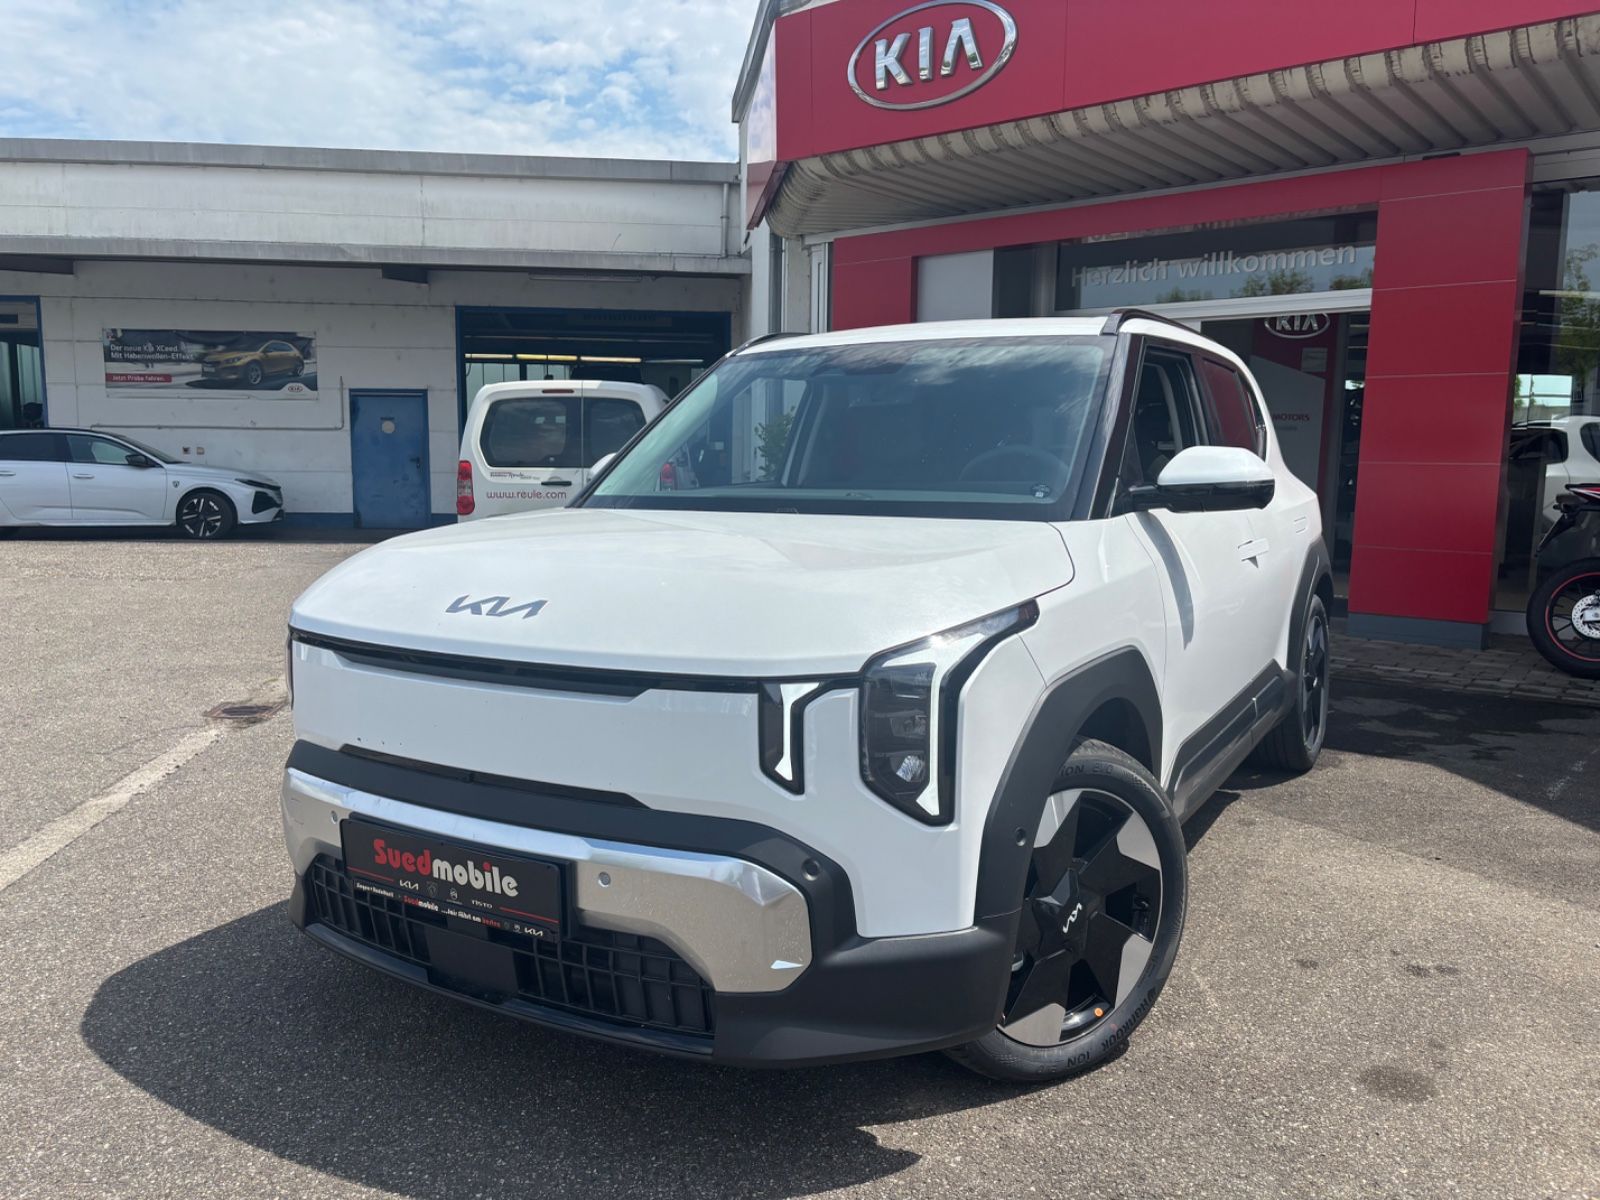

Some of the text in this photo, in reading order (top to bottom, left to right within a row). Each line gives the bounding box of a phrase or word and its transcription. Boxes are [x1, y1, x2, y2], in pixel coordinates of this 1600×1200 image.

[875, 17, 983, 90] KIA
[1071, 244, 1357, 288] Herzlich willkommen
[1276, 313, 1318, 331] KIA
[486, 489, 567, 500] www.reule.com
[445, 594, 549, 619] KIA
[373, 838, 519, 897] Suedmobile
